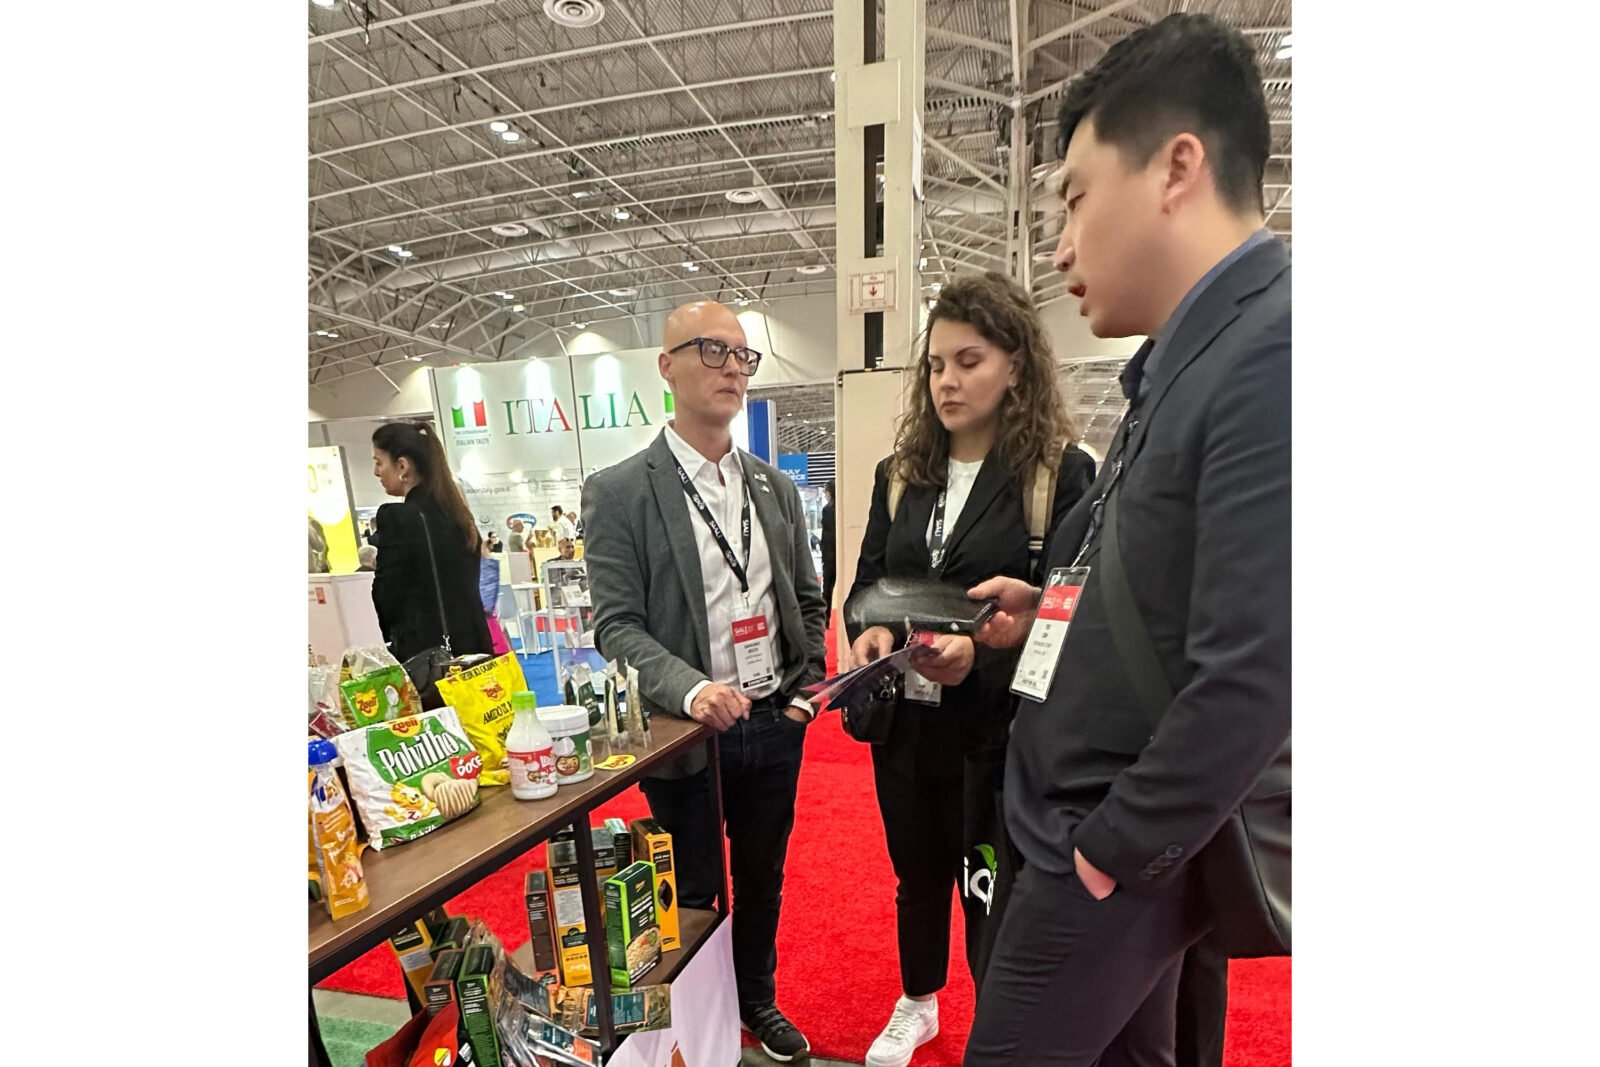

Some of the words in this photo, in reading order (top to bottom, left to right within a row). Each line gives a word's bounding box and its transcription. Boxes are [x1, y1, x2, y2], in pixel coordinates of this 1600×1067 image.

[501, 390, 653, 436] ITALIA
[375, 730, 461, 781] Polvilho
[456, 755, 483, 777] DOCE
[407, 811, 420, 821] Z
